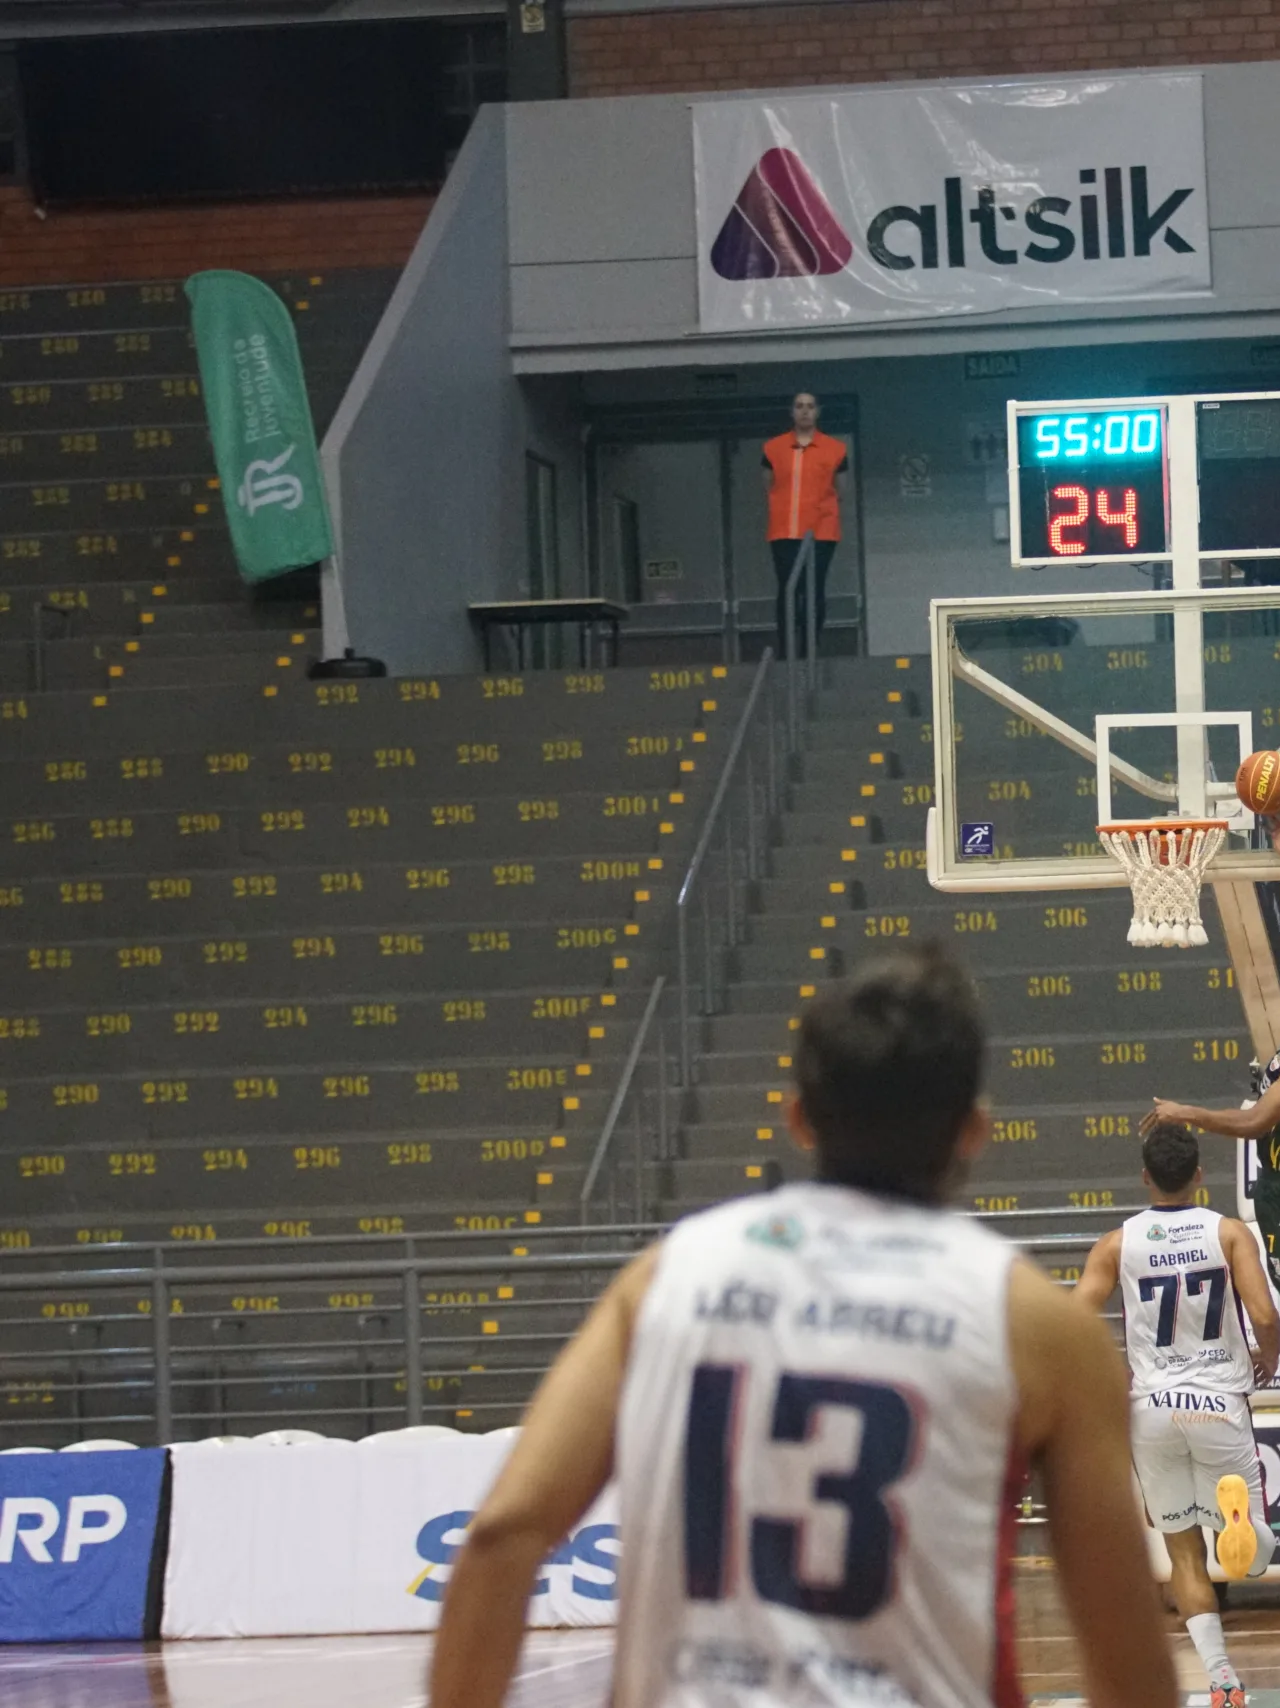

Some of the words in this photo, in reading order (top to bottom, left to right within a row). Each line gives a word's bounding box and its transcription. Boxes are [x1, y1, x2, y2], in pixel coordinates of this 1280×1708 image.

[866, 166, 1196, 271] altsilk
[234, 339, 248, 364] da
[249, 334, 281, 437] Juventude
[237, 368, 261, 443] Recreio
[1037, 413, 1158, 458] 55:00
[1050, 486, 1137, 555] 24
[400, 681, 440, 702] 294
[208, 752, 249, 773] 290
[375, 748, 415, 768] 294
[1256, 755, 1276, 801] PENALTY
[432, 806, 475, 825] 296
[518, 801, 559, 822] 298
[603, 797, 646, 816] 300
[260, 810, 304, 831] 292
[347, 808, 389, 828] 294
[320, 873, 363, 893] 294
[407, 870, 449, 889] 296
[492, 865, 534, 886] 298
[60, 883, 103, 903] 288
[866, 916, 909, 936] 302
[956, 912, 997, 932] 304
[1044, 908, 1087, 927] 306
[292, 937, 335, 959] 294
[468, 931, 510, 952] 298
[29, 949, 71, 970] 288
[120, 946, 162, 968] 290
[1028, 975, 1072, 996] 306
[1118, 971, 1161, 992] 308
[174, 1012, 219, 1033] 292
[264, 1007, 307, 1028] 294
[352, 1003, 398, 1026] 296
[87, 1015, 131, 1036] 290
[1010, 1048, 1055, 1067] 306
[1101, 1043, 1146, 1063] 308
[1193, 1040, 1239, 1061] 310
[142, 1082, 188, 1103] 292
[234, 1079, 278, 1099] 294
[324, 1076, 369, 1097] 296
[415, 1072, 459, 1094] 298
[53, 1084, 98, 1105] 290
[992, 1121, 1037, 1141] 306
[1085, 1116, 1130, 1137] 308
[109, 1154, 156, 1175] 292
[203, 1149, 248, 1170] 294
[293, 1148, 340, 1169] 296
[387, 1143, 431, 1165] 298
[20, 1156, 65, 1177] 290
[1168, 1223, 1204, 1234] Fortaleza
[1150, 1248, 1208, 1267] GABRIEL
[1138, 1264, 1229, 1348] 77
[1148, 1390, 1226, 1412] NATIVAS
[681, 1359, 928, 1621] 13
